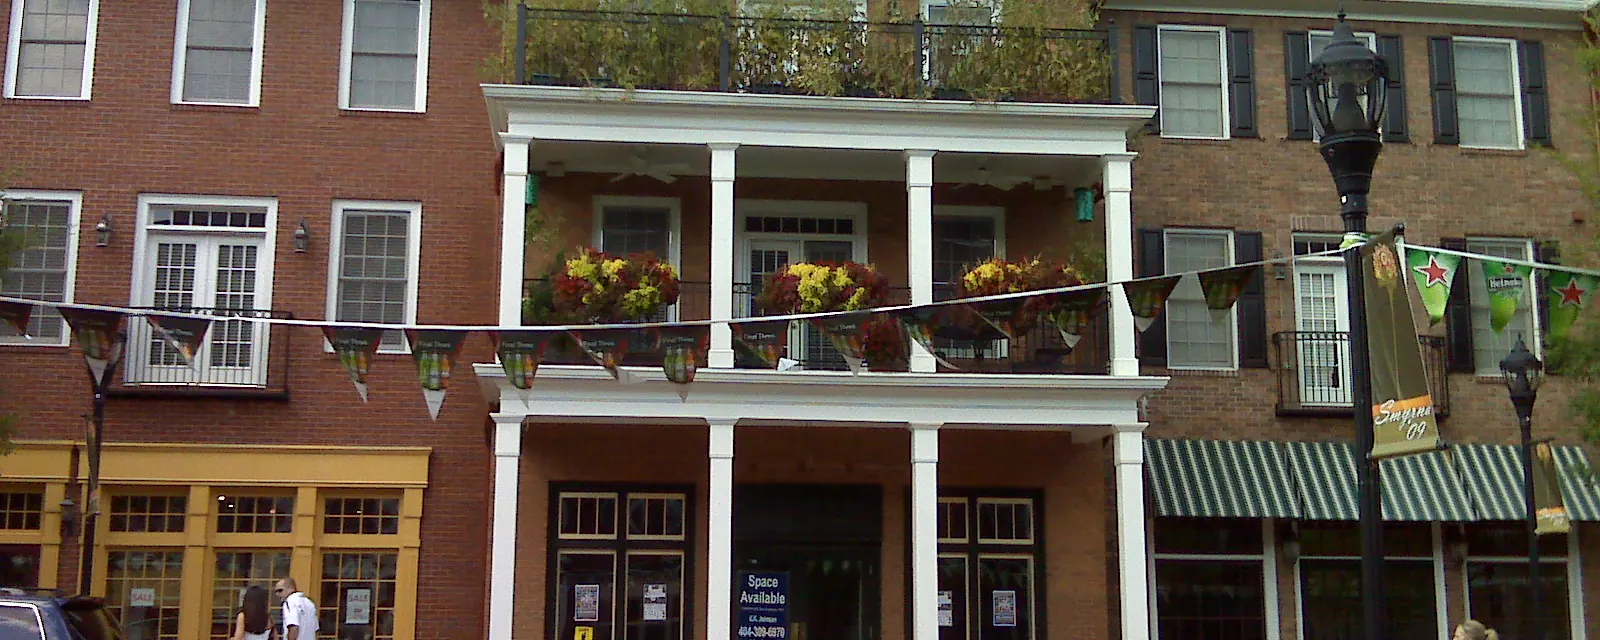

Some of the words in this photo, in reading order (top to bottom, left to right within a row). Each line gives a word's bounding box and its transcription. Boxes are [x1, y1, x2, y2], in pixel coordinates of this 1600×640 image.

[1489, 277, 1521, 289] Heineke
[1374, 399, 1431, 431] Smyrna
[748, 574, 778, 589] Space
[740, 590, 785, 604] Available
